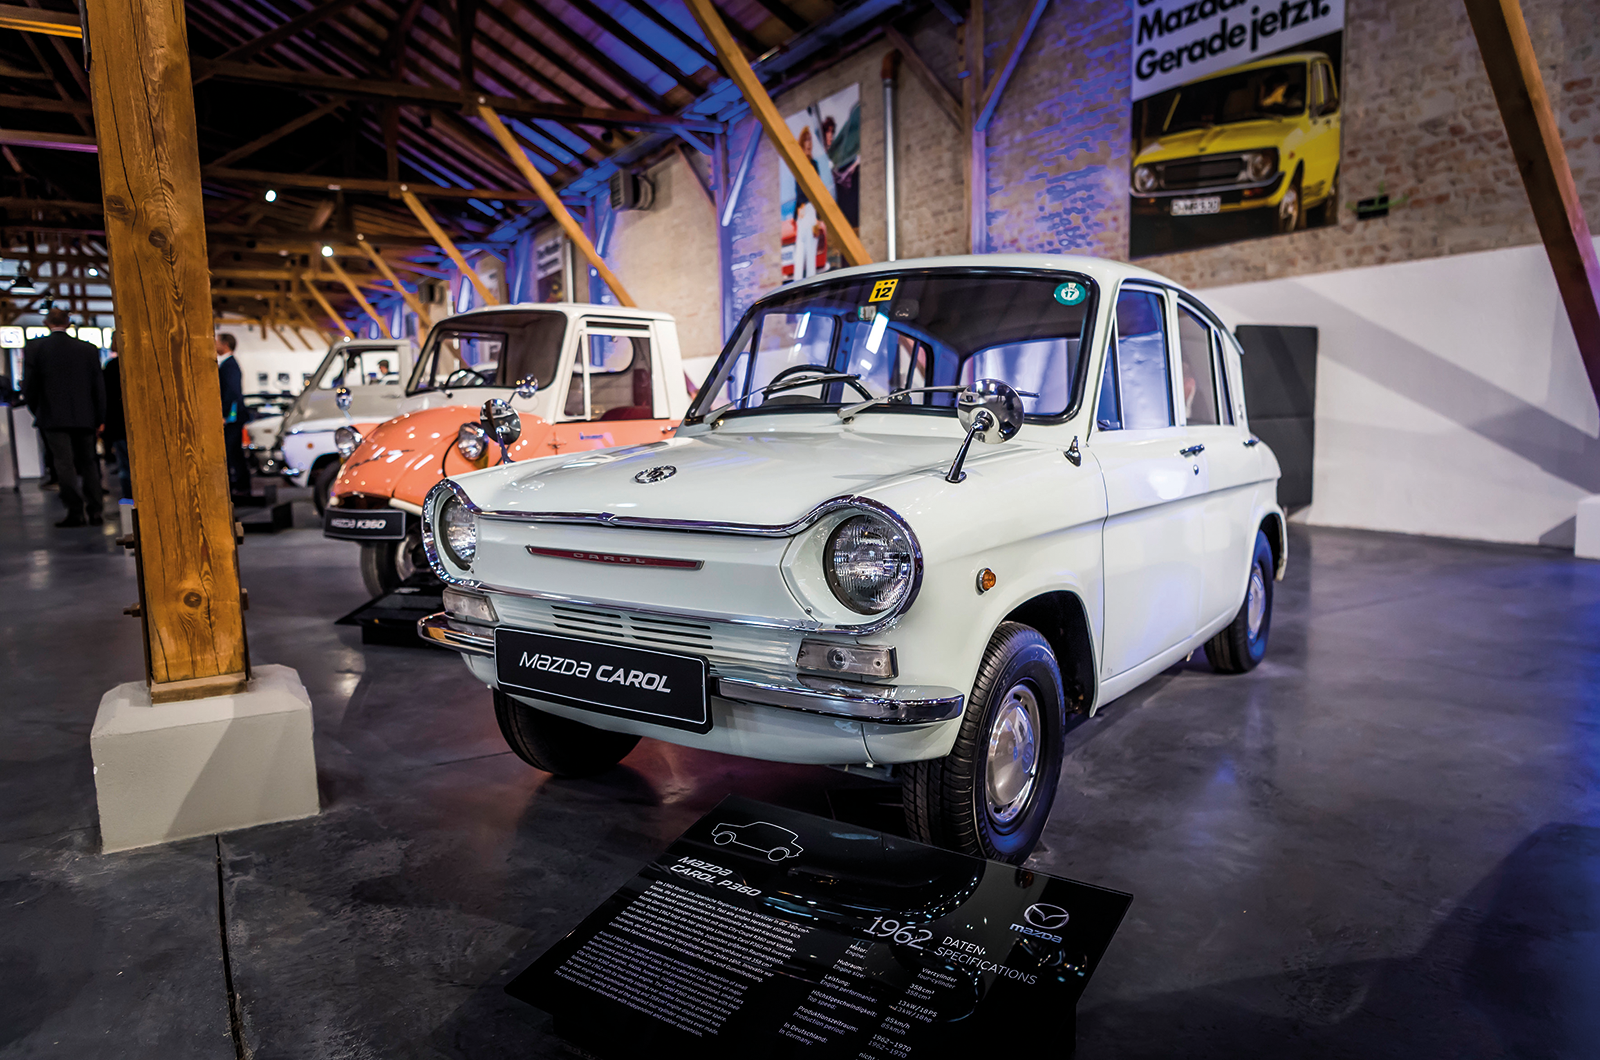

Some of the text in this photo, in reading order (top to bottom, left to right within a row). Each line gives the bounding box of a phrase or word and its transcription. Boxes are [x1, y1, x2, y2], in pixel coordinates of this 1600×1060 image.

[1135, 0, 1331, 80] Gerade jetzt.
[874, 286, 892, 299] 12
[1064, 290, 1076, 298] 17
[573, 552, 646, 564] CAROL
[595, 664, 672, 694] CAROL
[670, 864, 762, 897] CAROL P360
[863, 916, 933, 950] 1962
[844, 948, 866, 959] Engine:
[832, 963, 852, 974] Engine
[934, 946, 1038, 985] SPECIFICATIONS
[824, 973, 850, 986] Leistung:
[922, 967, 957, 982] Vierzylinder
[819, 979, 877, 1003] Engine performance:
[807, 994, 837, 1010] Top speed:
[792, 1011, 845, 1035] Production period:
